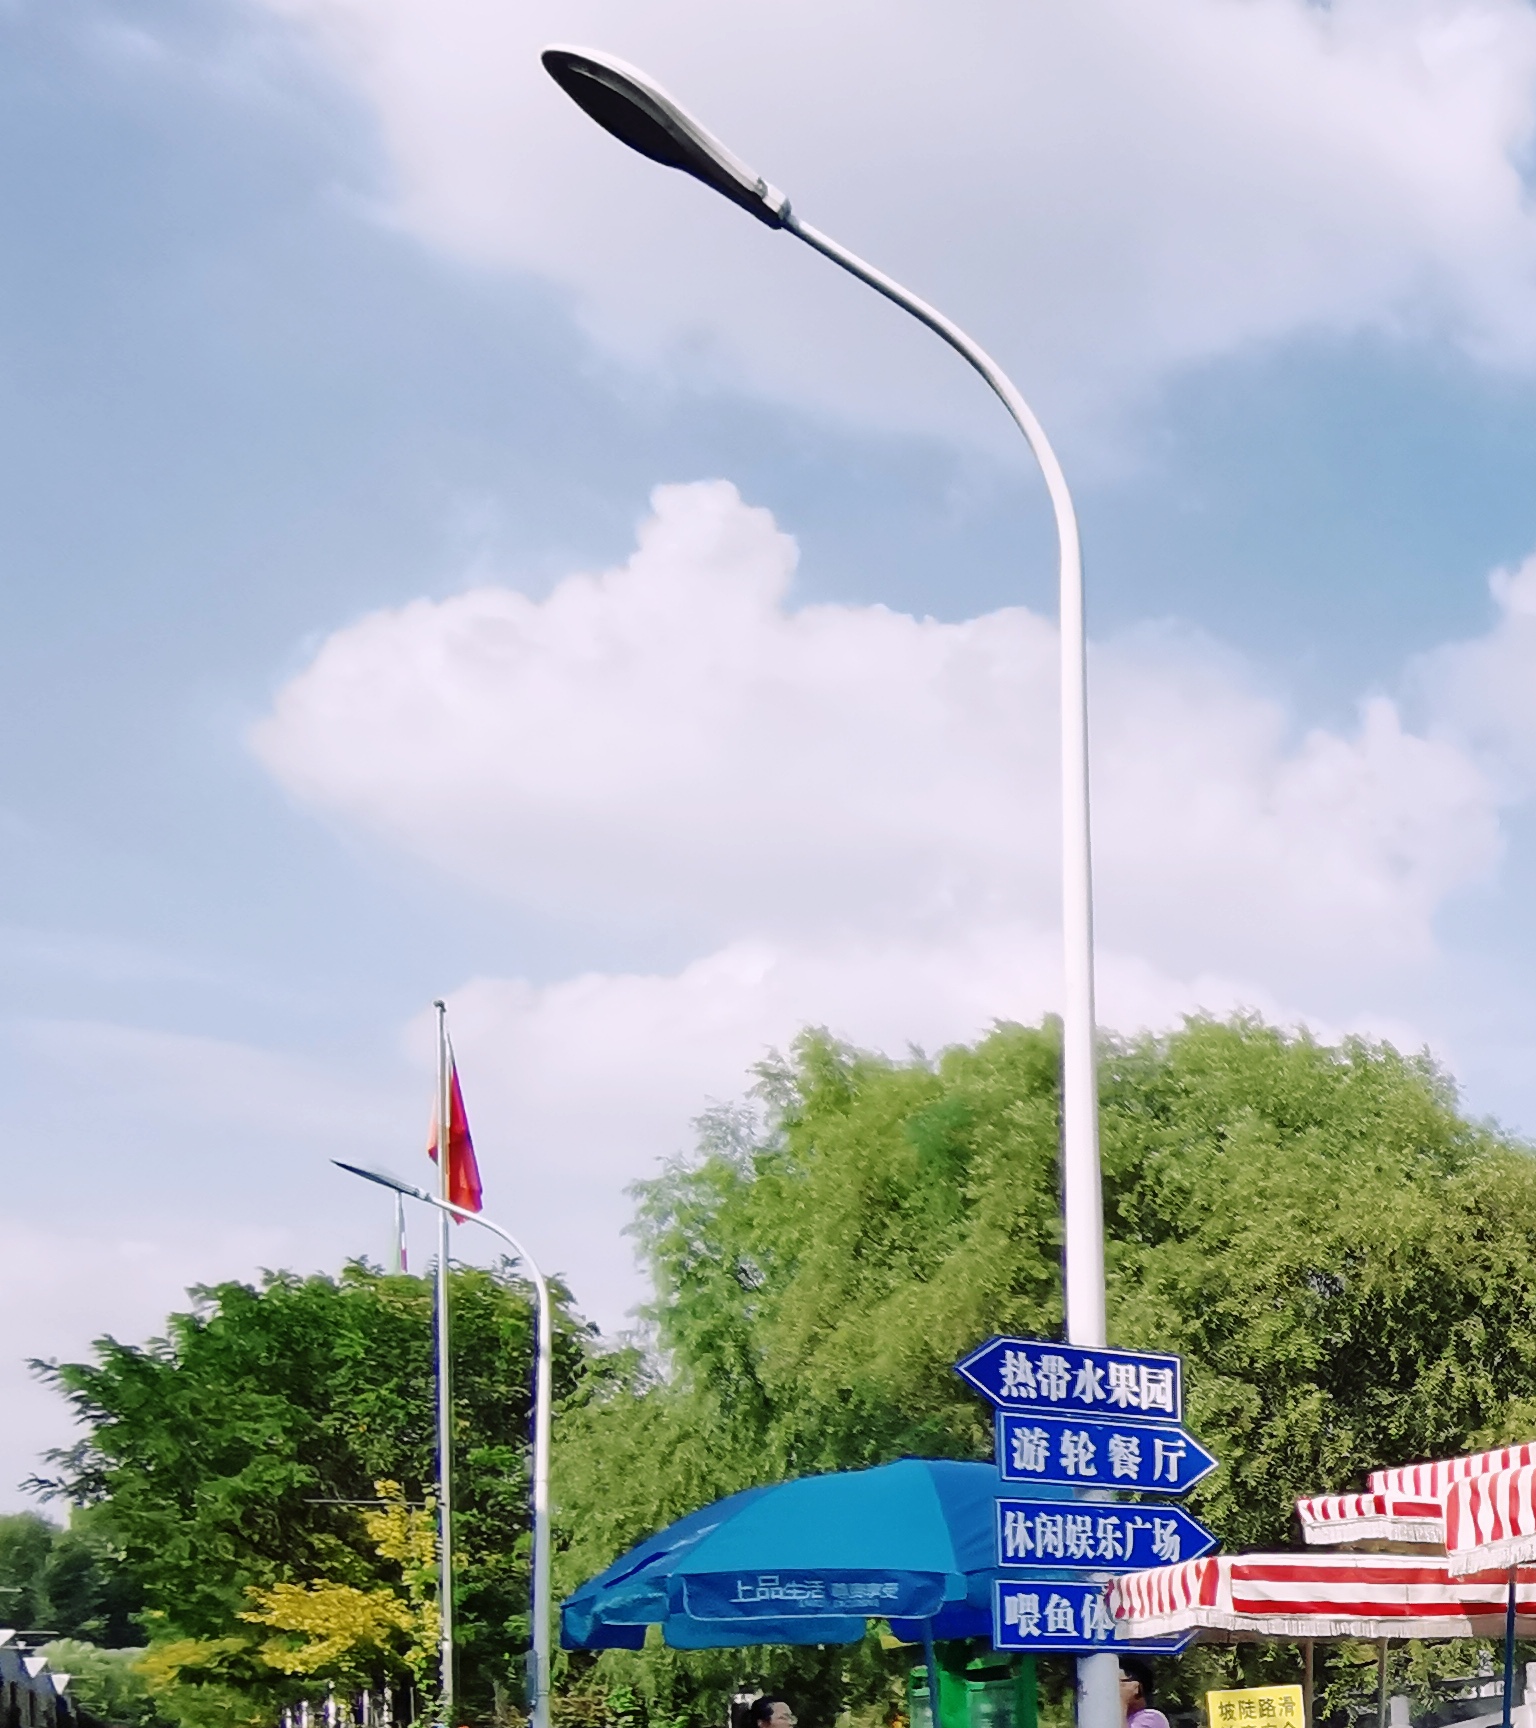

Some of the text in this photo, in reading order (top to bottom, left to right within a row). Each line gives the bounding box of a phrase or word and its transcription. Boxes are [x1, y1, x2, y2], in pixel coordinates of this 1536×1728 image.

[999, 1350, 1174, 1413] 热带水果园
[1011, 1426, 1187, 1482] 游轮餐厅
[1004, 1510, 1182, 1563] 休闲娱乐广场
[1004, 1592, 1179, 1641] 喂鱼体
[1218, 1696, 1297, 1722] 坡陡路滑
